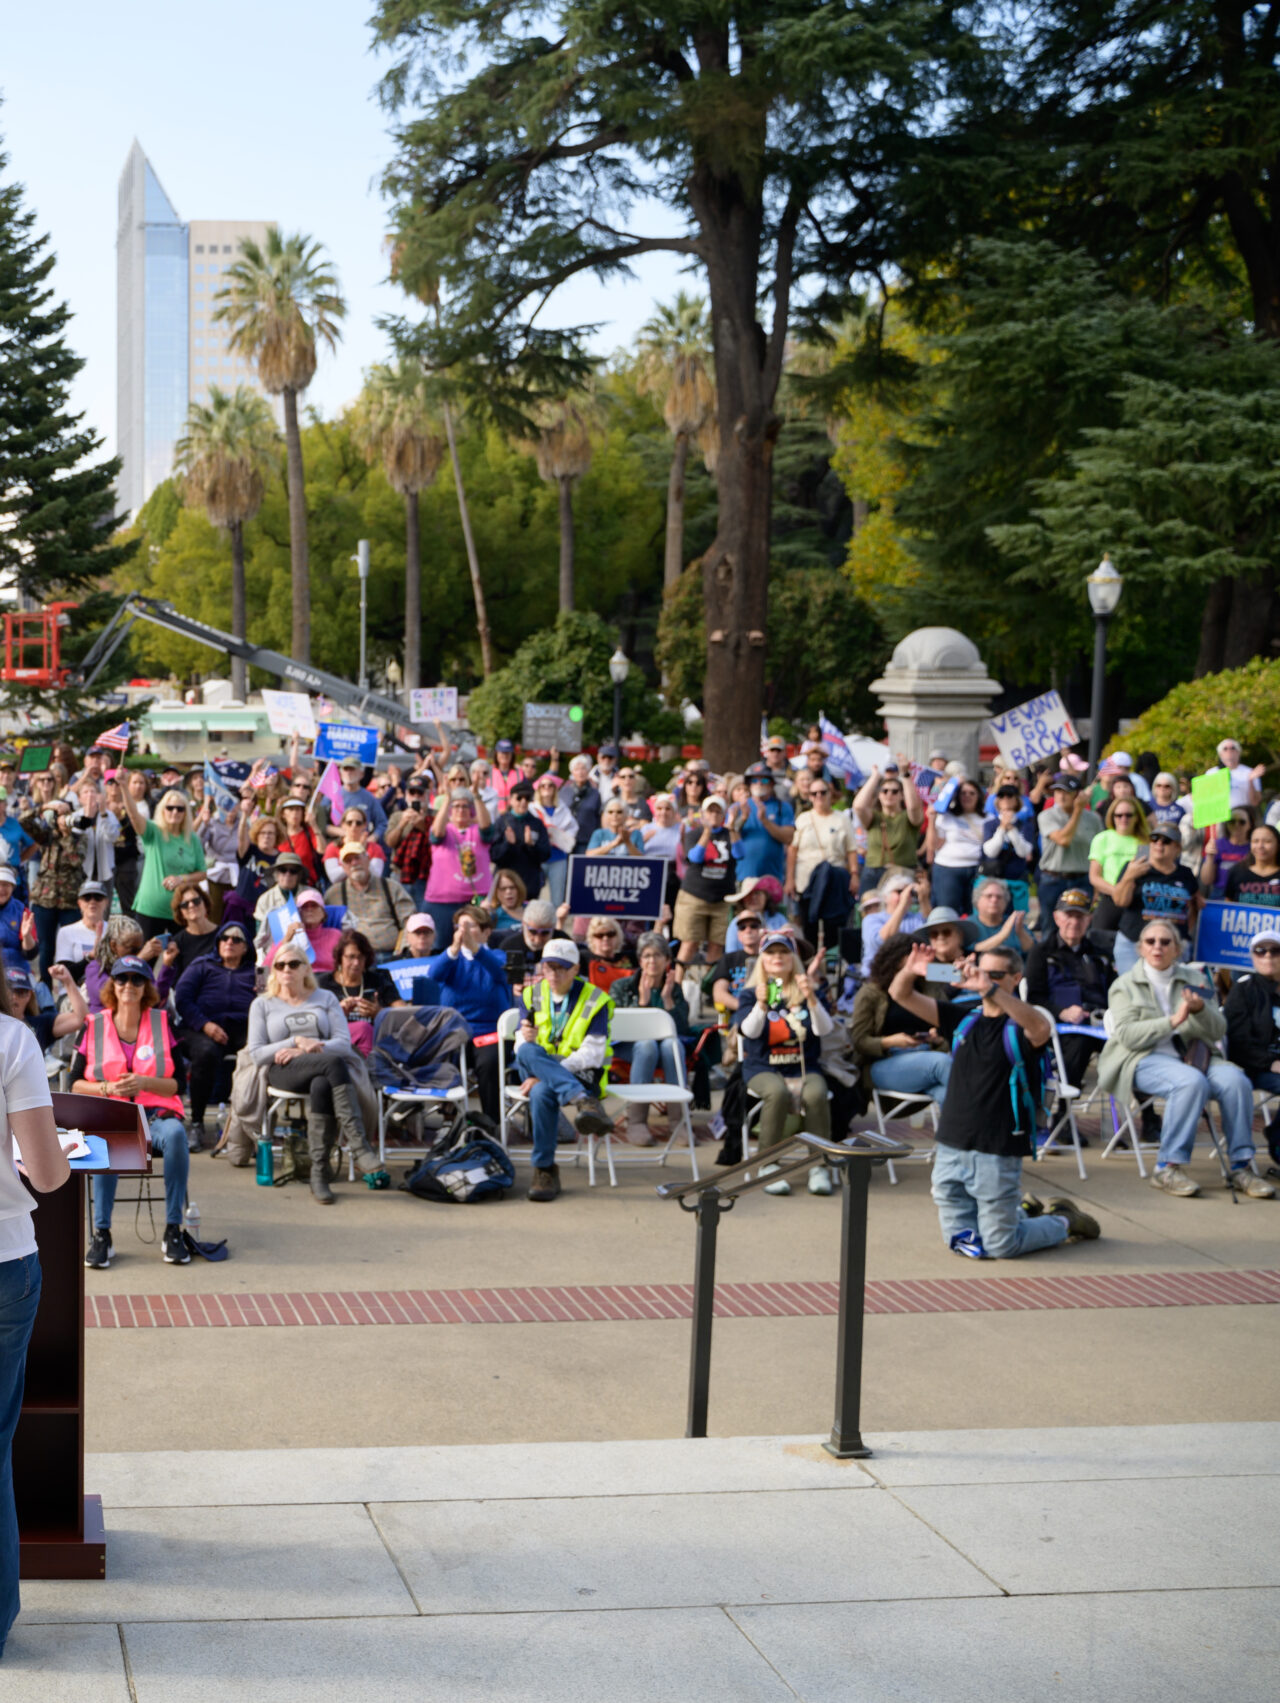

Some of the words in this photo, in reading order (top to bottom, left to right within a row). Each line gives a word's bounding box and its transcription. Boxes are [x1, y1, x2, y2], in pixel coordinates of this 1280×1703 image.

[326, 725, 368, 743] HARRIS
[1021, 719, 1047, 740] GO
[584, 865, 652, 889] HARRIS
[593, 888, 640, 902] WALZ
[1220, 908, 1280, 935] HARRI
